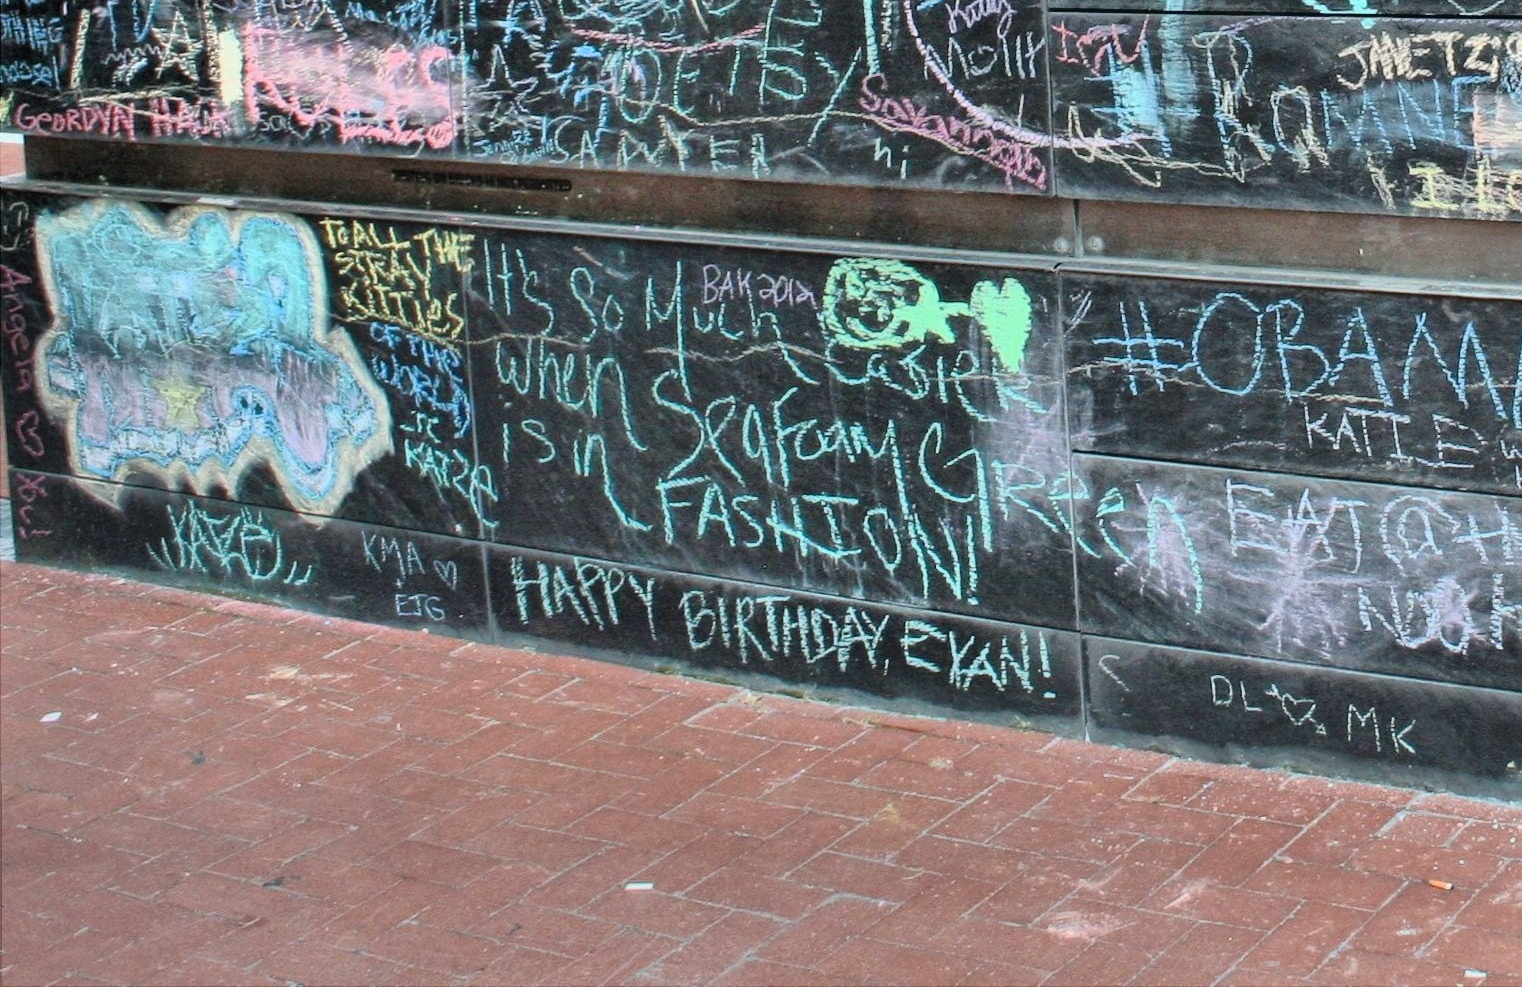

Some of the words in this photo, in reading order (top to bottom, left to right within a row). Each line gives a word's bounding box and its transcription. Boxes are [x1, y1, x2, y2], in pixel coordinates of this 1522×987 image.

[1303, 401, 1488, 469] KATIE
[510, 555, 658, 642] HAPPY
[1346, 701, 1419, 757] MK
